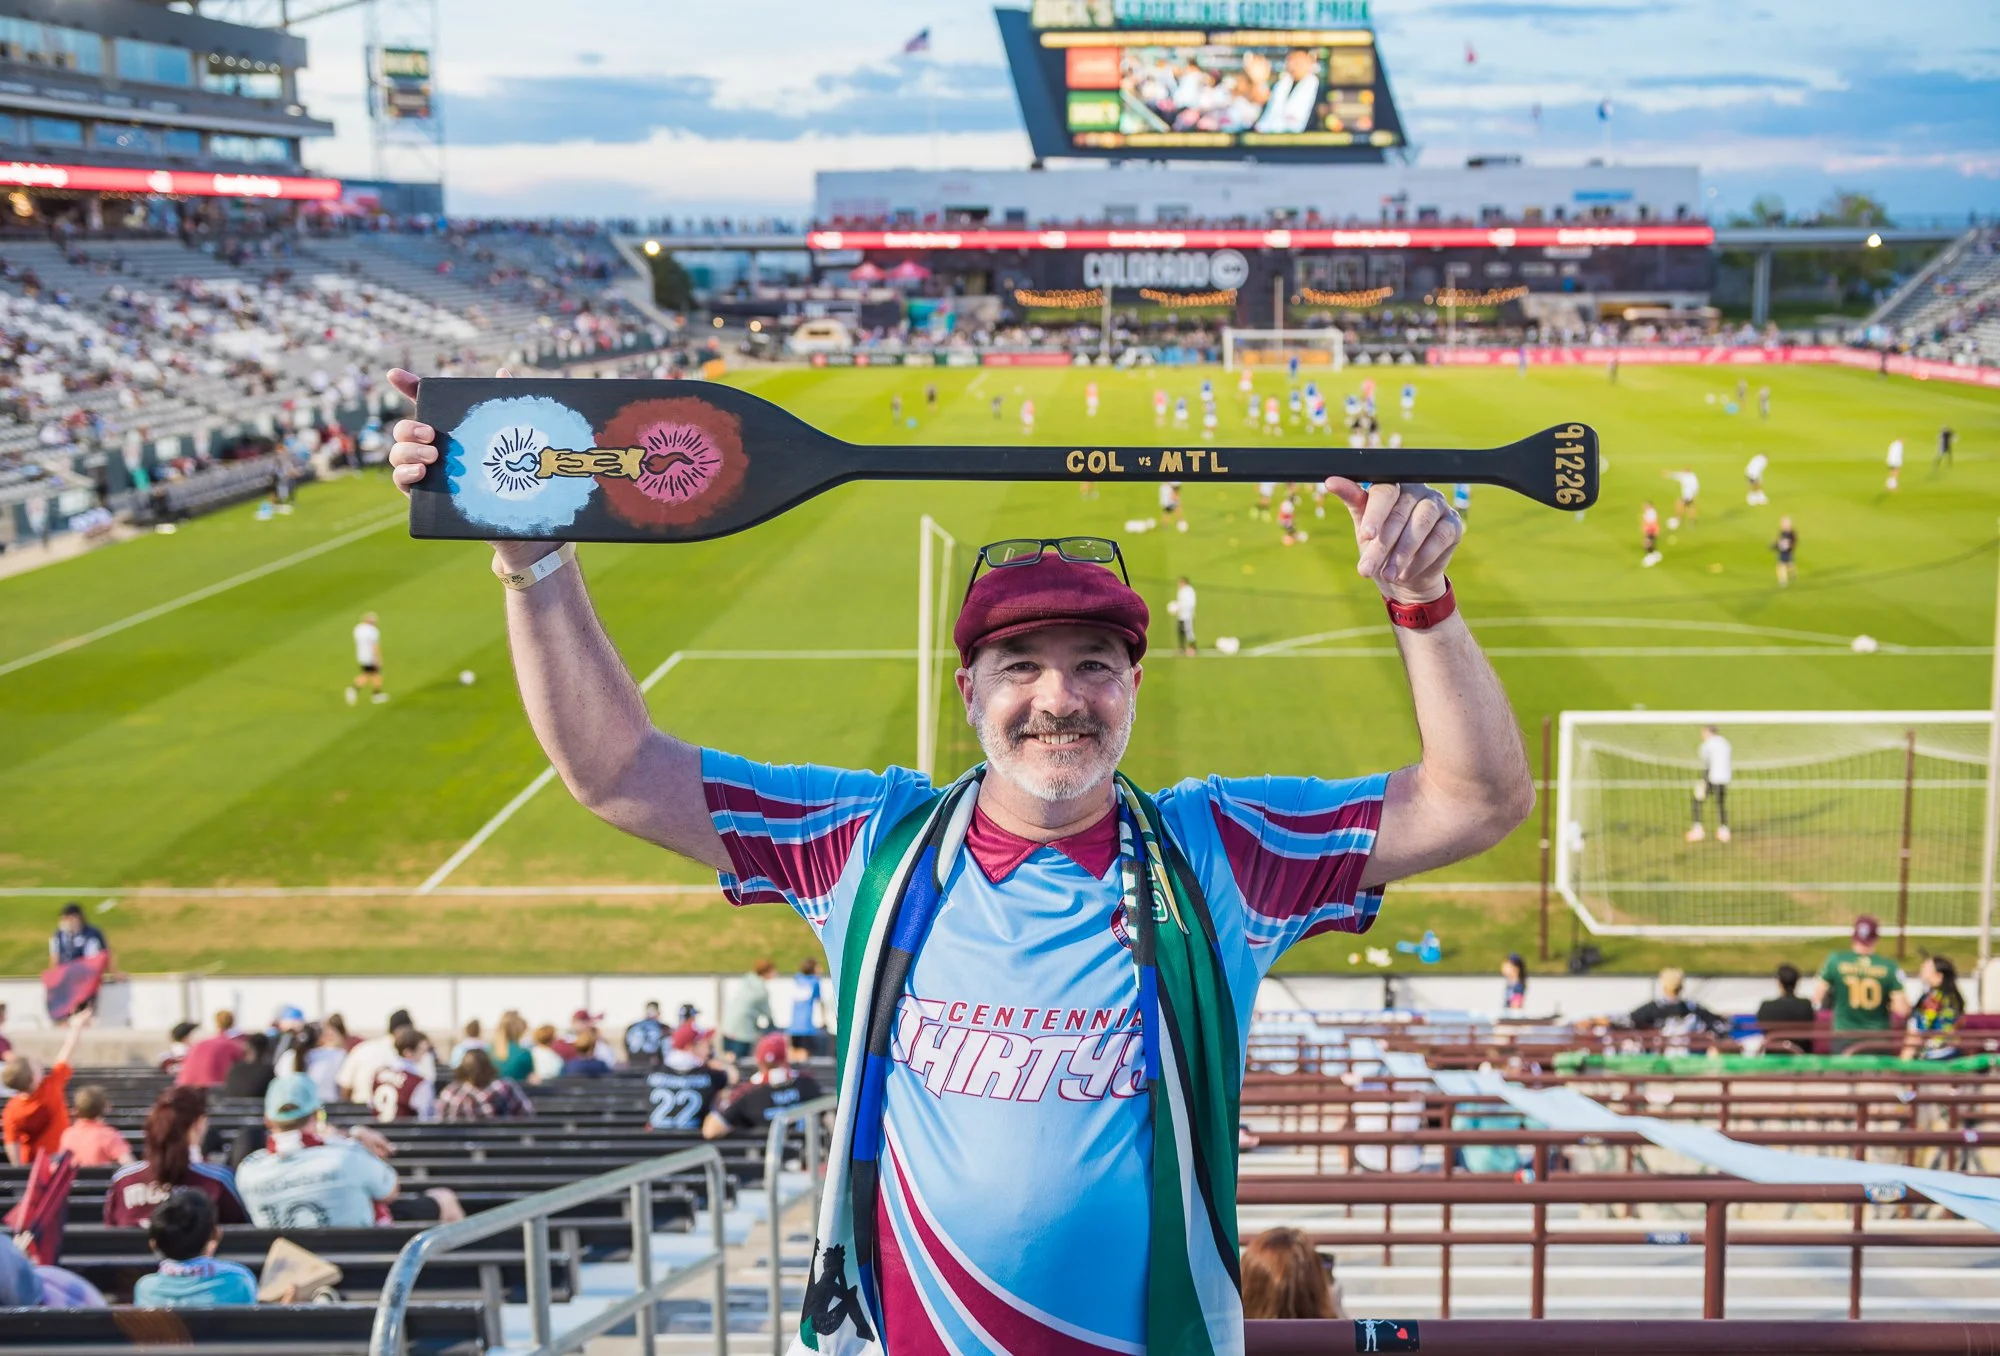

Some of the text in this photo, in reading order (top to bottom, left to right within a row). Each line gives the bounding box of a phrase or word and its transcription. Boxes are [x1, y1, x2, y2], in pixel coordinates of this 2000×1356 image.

[1083, 252, 1209, 288] COLORADO
[1066, 450, 1124, 474] COL
[1158, 450, 1228, 473] MTL
[1842, 975, 1883, 1010] 10
[948, 1001, 1142, 1031] CENTENNIA
[650, 1087, 703, 1129] 22
